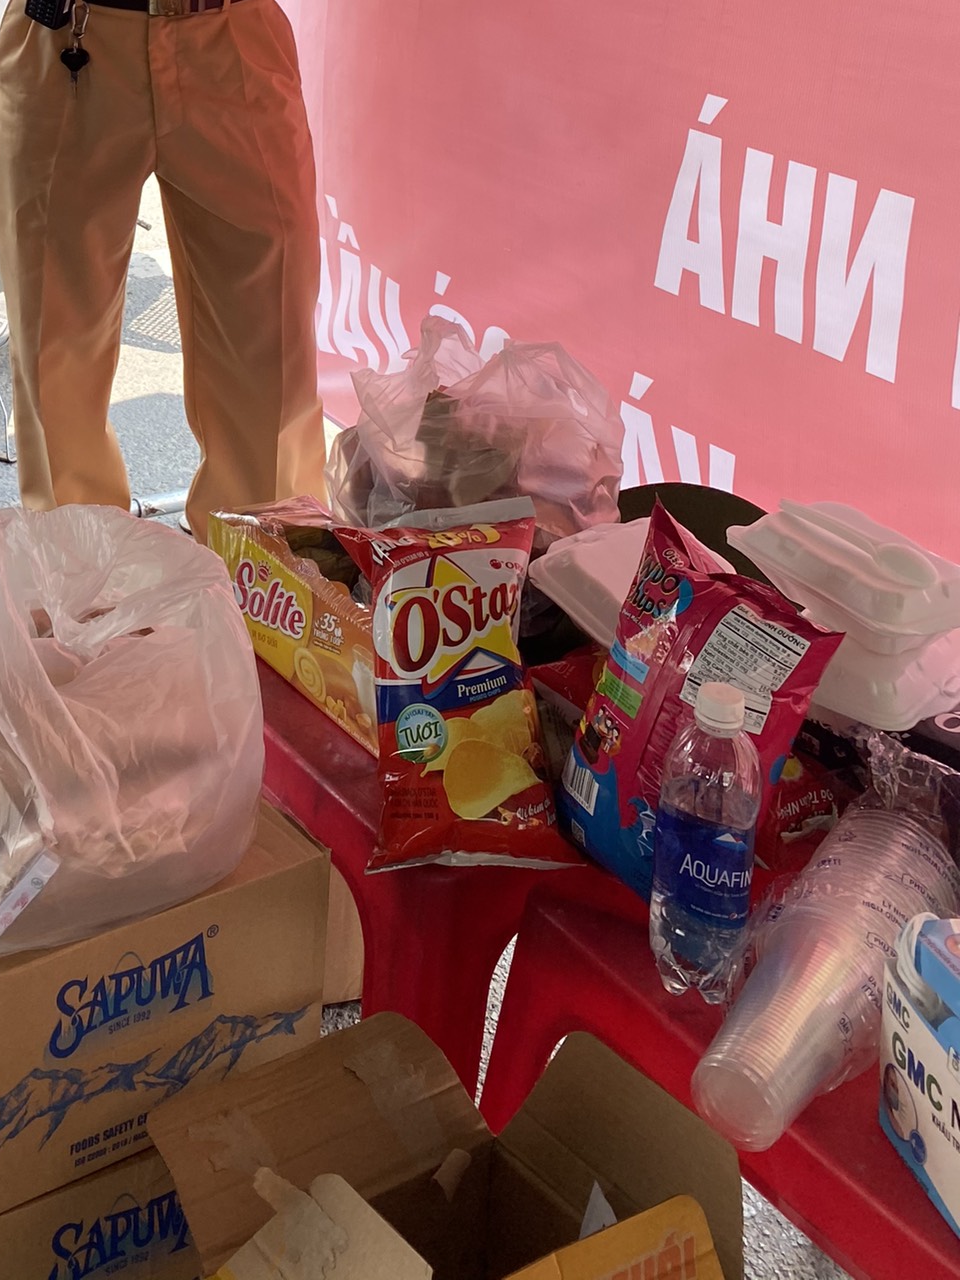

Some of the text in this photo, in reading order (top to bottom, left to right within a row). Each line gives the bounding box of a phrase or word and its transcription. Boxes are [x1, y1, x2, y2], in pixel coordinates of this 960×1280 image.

[235, 559, 306, 639] Solite
[456, 674, 508, 698] Premium
[679, 853, 752, 888] AQUAFIN
[49, 932, 215, 1059] SAPUWA
[886, 982, 910, 1029] GMC
[109, 1009, 152, 1035] SINCE 1992
[892, 1031, 943, 1112] GMC
[70, 1133, 101, 1156] FOODS
[102, 1118, 135, 1141] SAFETY
